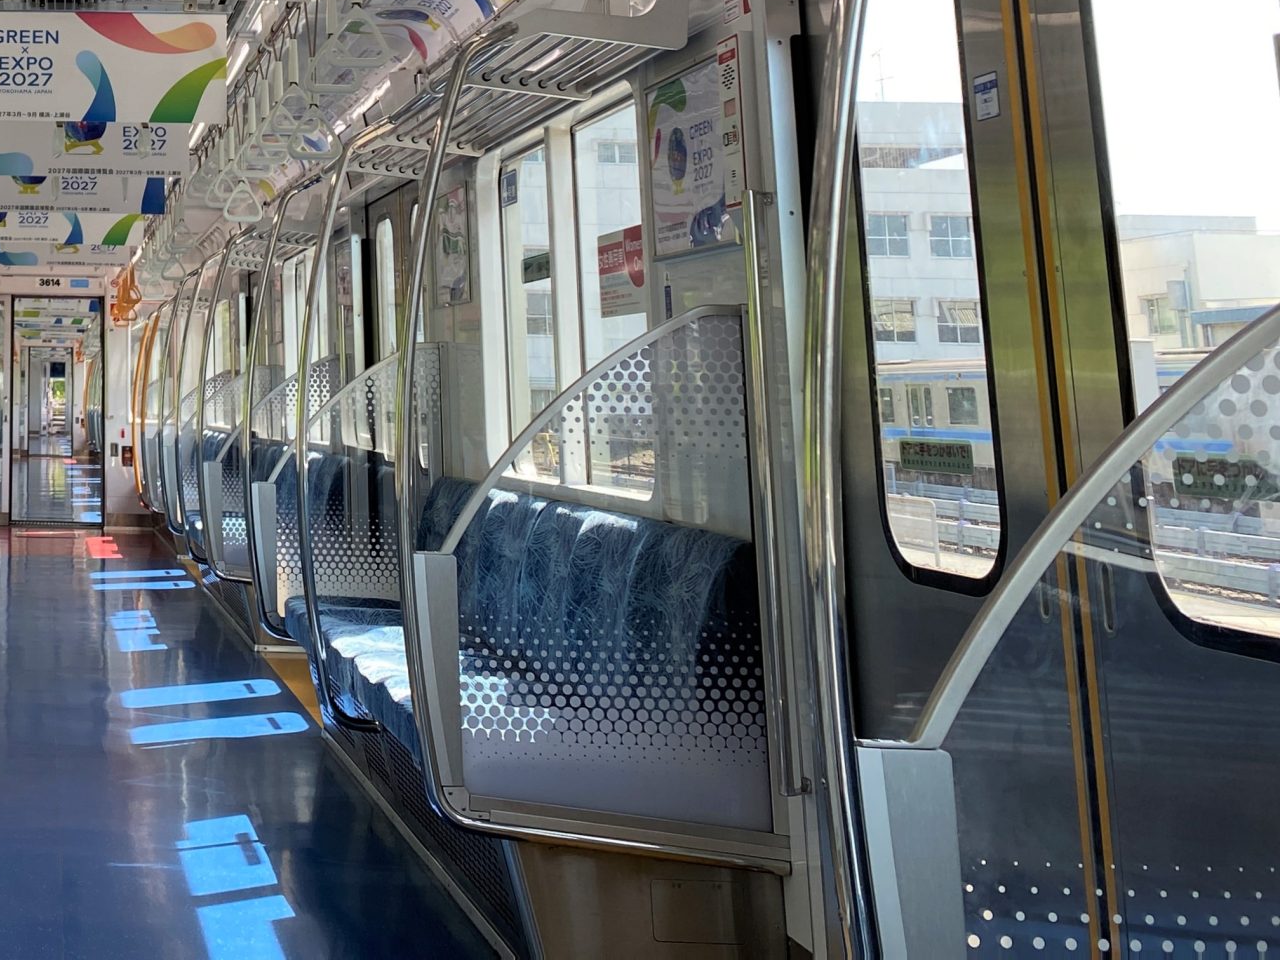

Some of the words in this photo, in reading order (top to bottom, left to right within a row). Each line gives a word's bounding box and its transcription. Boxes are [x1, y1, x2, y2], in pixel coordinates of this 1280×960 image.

[692, 147, 713, 167] EXPO
[693, 163, 713, 183] 2027
[62, 180, 98, 191] 2027
[18, 215, 49, 225] 2027
[39, 278, 61, 287] 3614
